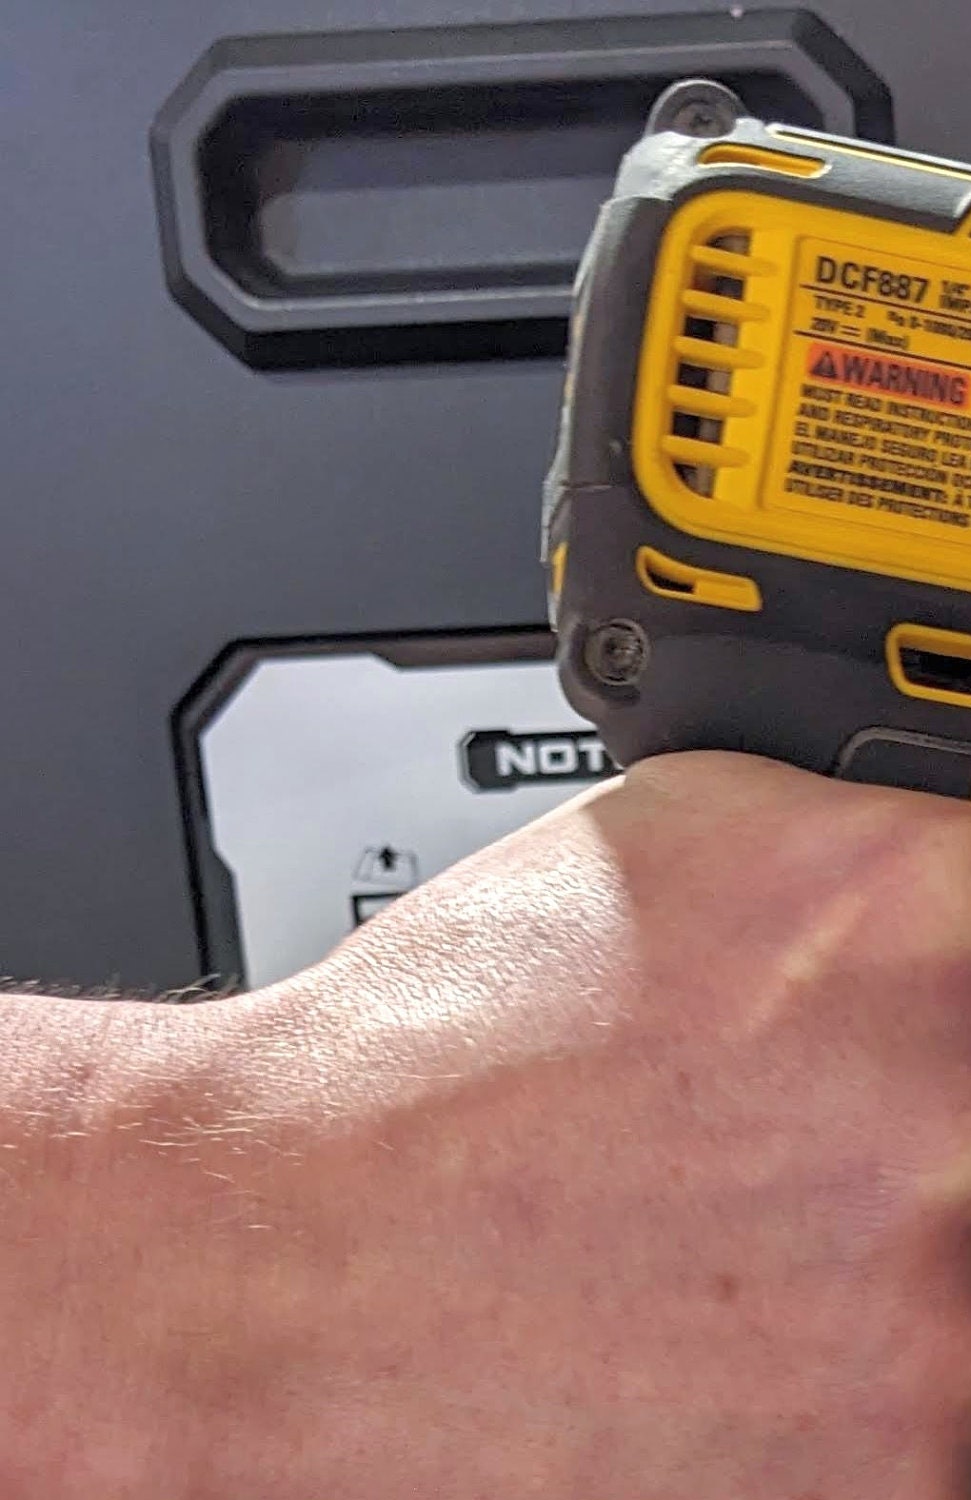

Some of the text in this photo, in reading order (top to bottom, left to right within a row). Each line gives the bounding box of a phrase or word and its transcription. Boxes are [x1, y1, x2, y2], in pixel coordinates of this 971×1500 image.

[816, 256, 928, 303] DCF887
[814, 295, 851, 315] TYPE
[841, 354, 968, 405] WARNING
